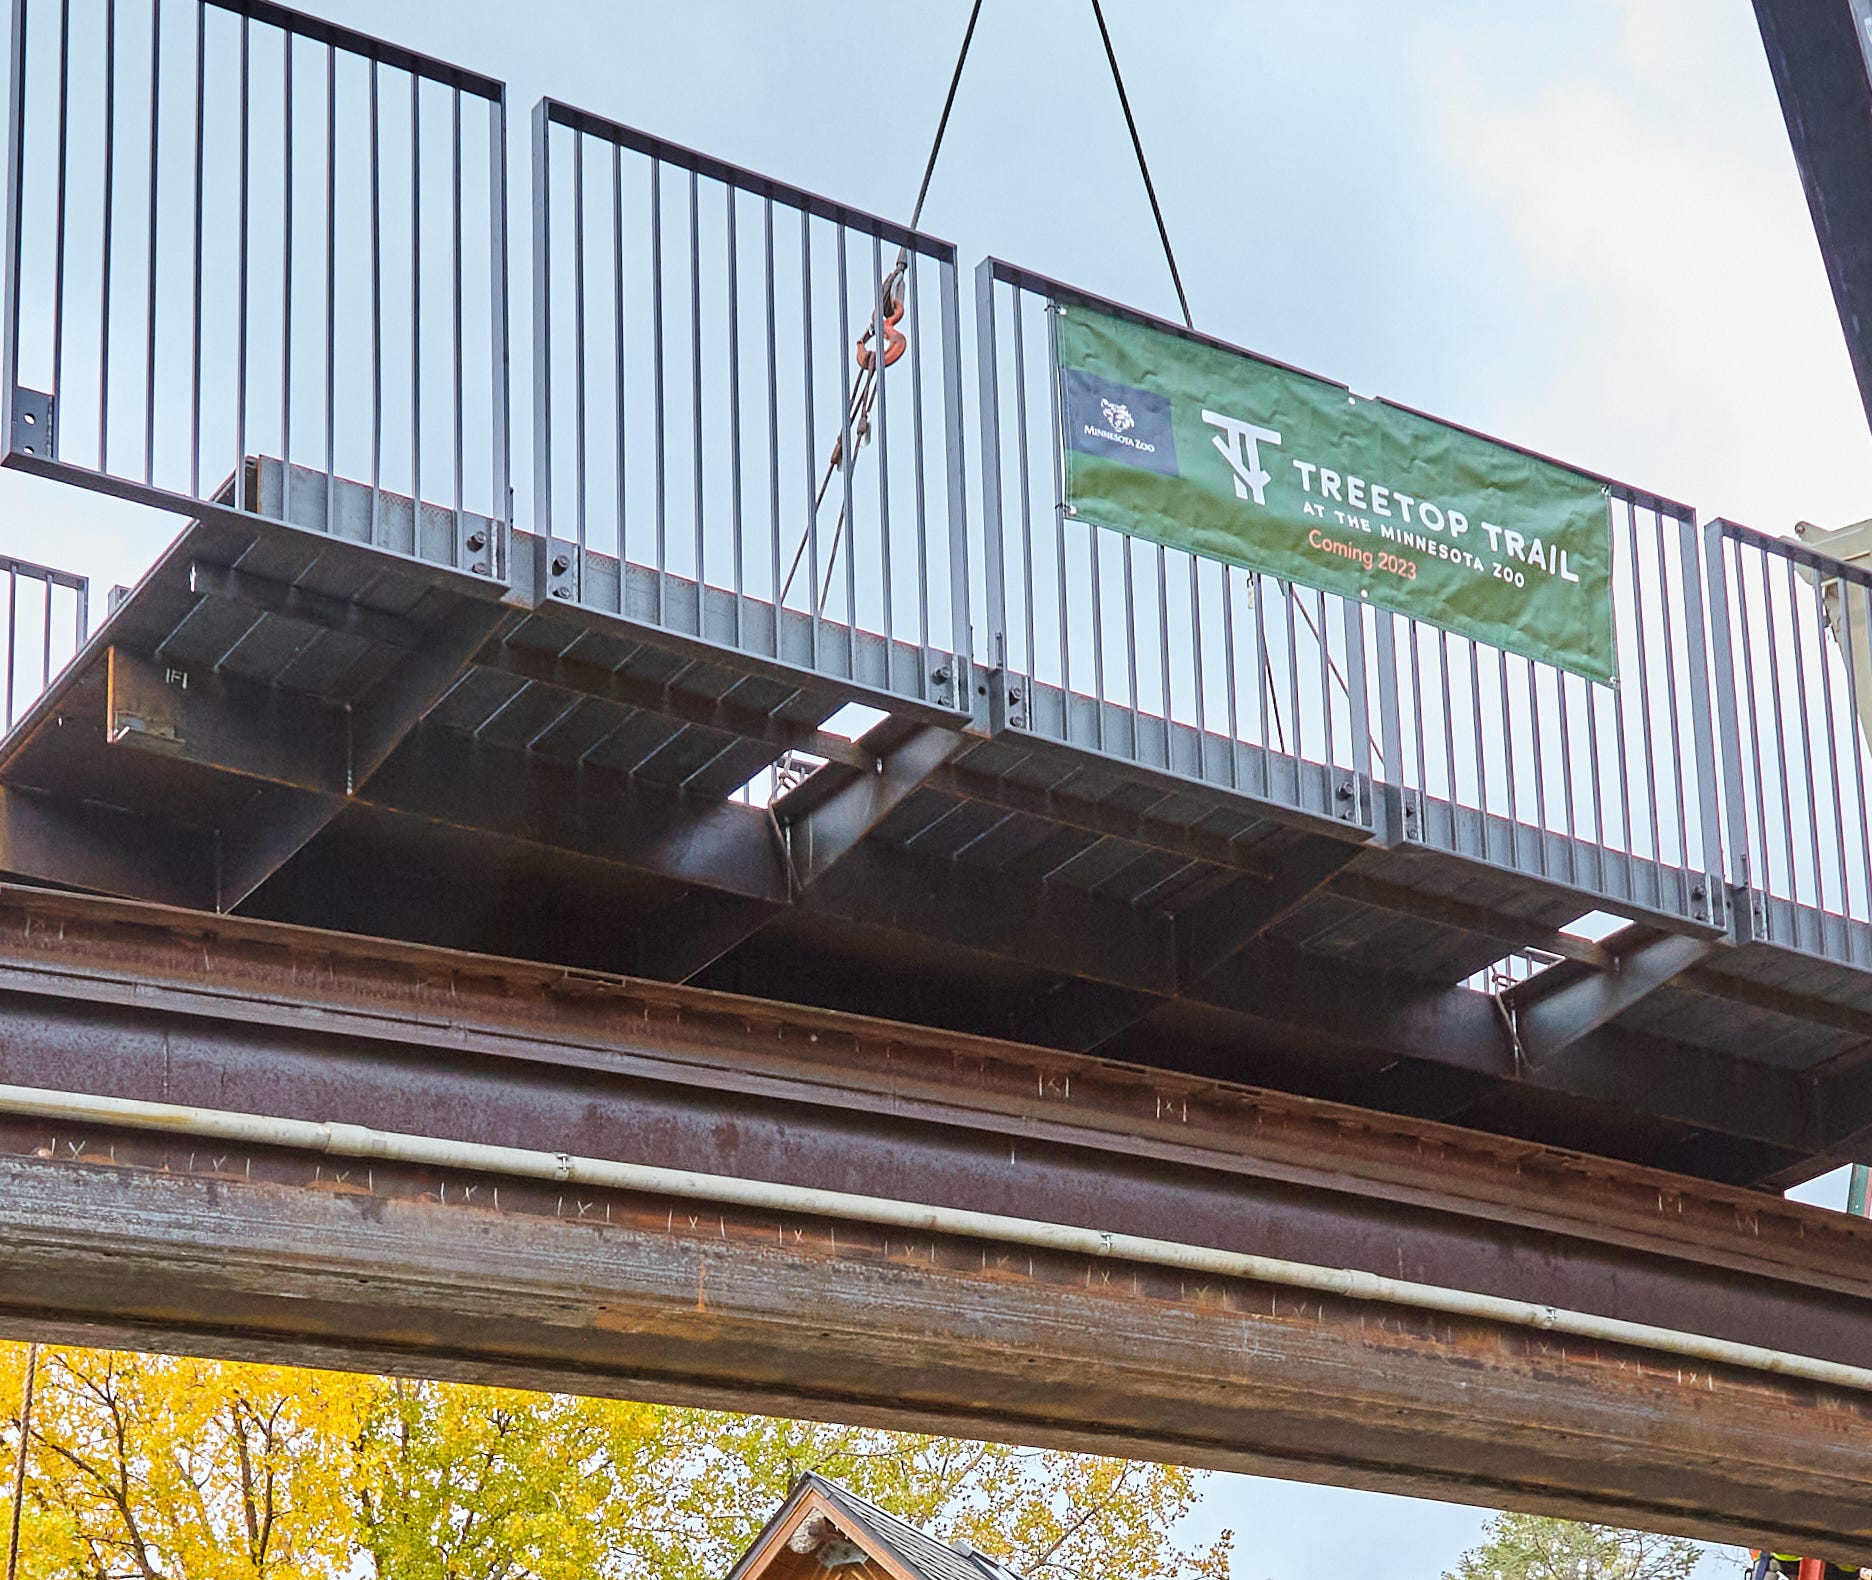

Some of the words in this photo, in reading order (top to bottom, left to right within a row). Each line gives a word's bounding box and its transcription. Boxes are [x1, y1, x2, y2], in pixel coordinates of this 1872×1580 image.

[1084, 424, 1134, 447] MINNESOTA
[1135, 439, 1156, 453] ZOO
[1292, 459, 1469, 538] TREETOP
[1481, 521, 1580, 583] TRAIL
[1303, 501, 1325, 519] AT
[1334, 510, 1371, 533] THE
[1380, 524, 1485, 573] MINNESOTA
[1492, 562, 1525, 588] ZOO
[1308, 529, 1374, 571] Coming
[1378, 552, 1418, 580] 2023
